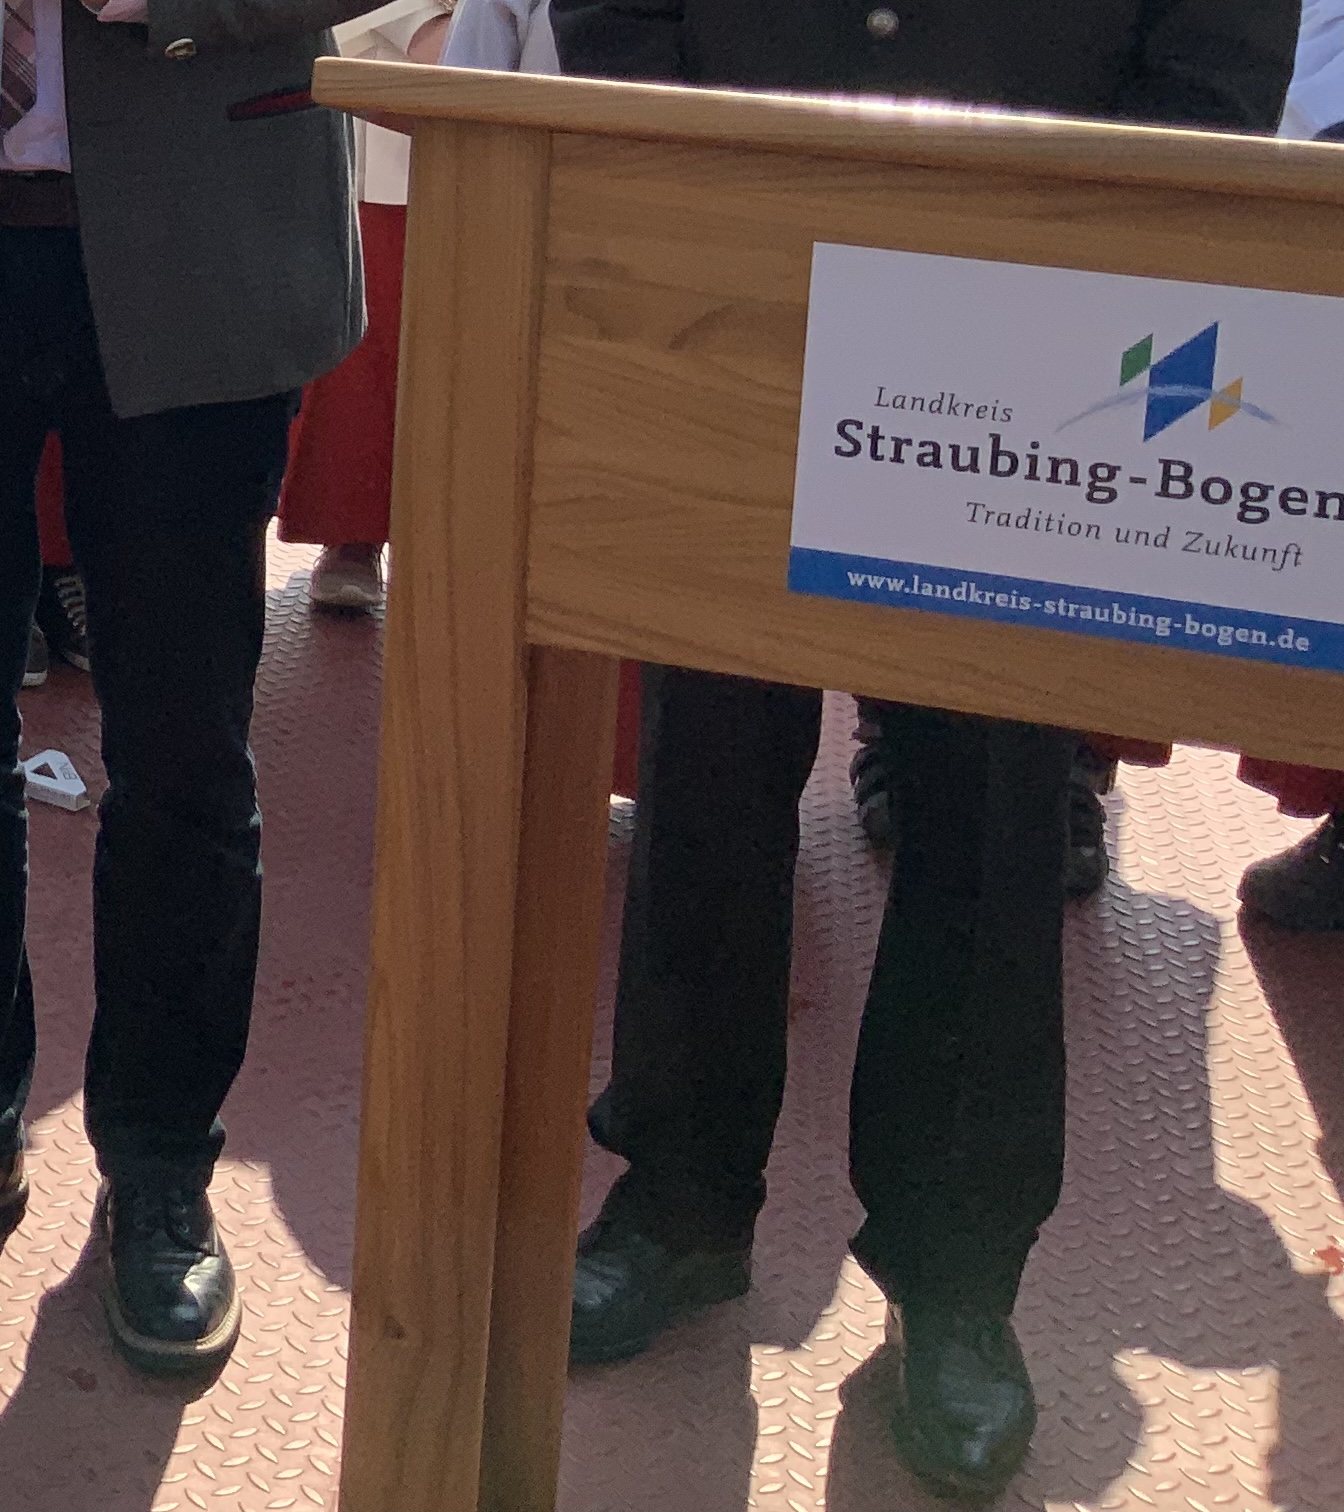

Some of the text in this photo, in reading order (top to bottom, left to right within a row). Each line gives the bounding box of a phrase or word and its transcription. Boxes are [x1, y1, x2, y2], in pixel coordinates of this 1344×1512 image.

[875, 386, 1013, 422] Landkreis
[834, 418, 1344, 524] Straubing-Bogen
[966, 501, 1303, 572] Tradition und Zukunft
[847, 570, 1310, 652] www.landkreis-straubing-bogen.de
